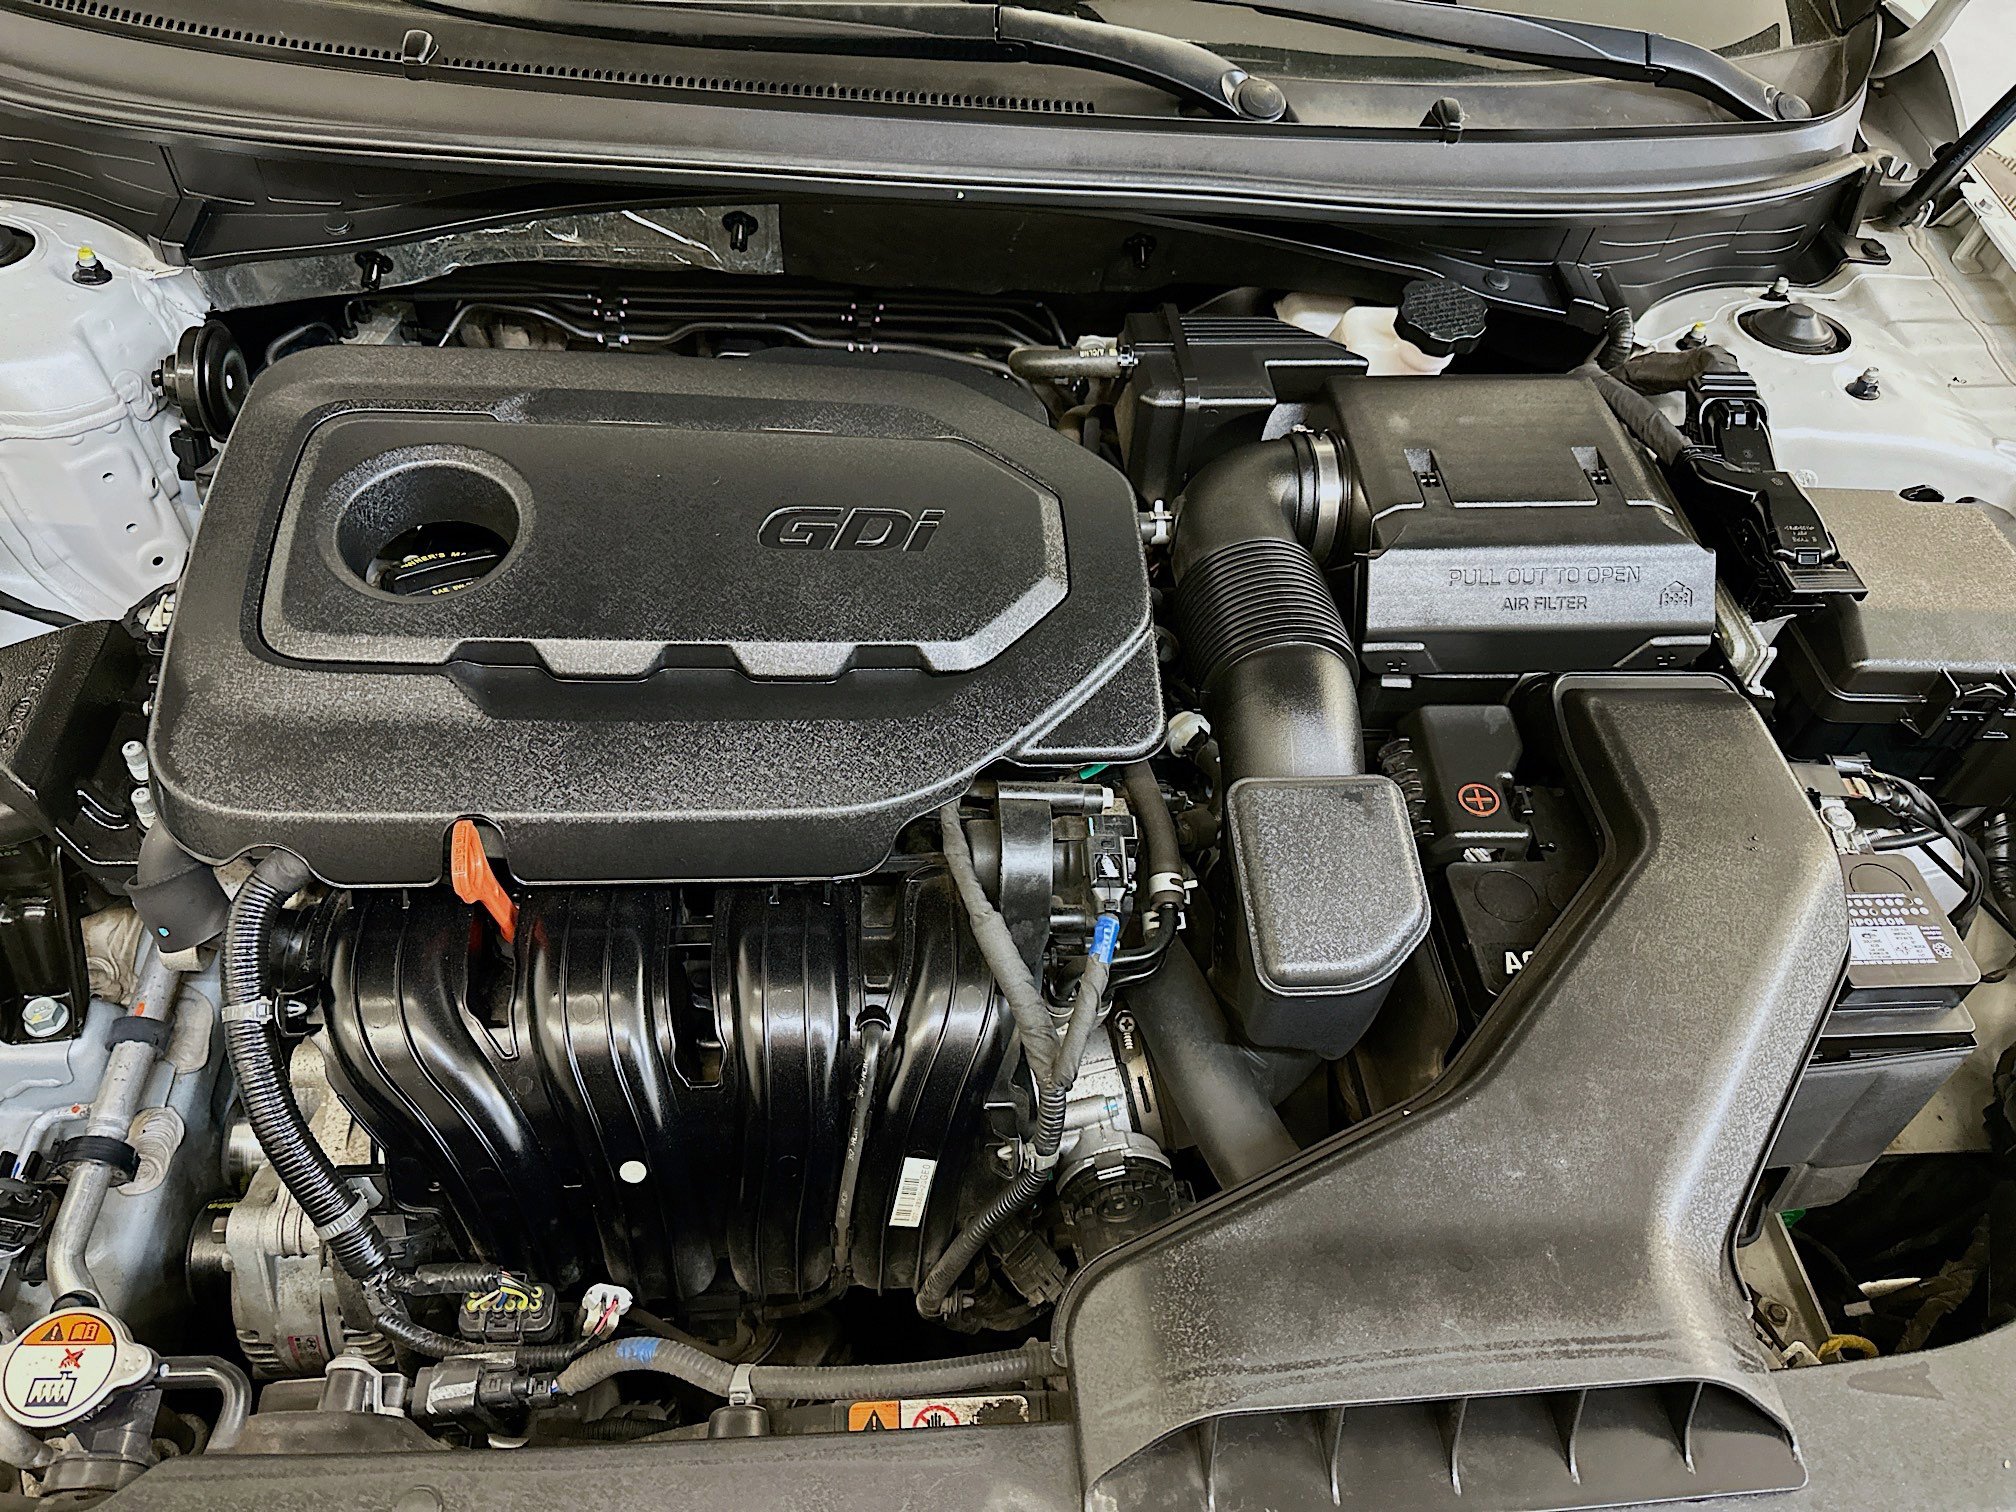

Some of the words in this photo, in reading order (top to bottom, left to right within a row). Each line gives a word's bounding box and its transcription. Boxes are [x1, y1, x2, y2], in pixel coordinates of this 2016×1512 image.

[757, 506, 945, 551] GDi
[1449, 568, 1500, 587] PULL
[1507, 567, 1547, 585] OUT
[1553, 567, 1579, 584] TO
[1587, 565, 1640, 583] OPEN
[431, 586, 451, 595] SAE
[1502, 597, 1529, 611] AIR
[1534, 596, 1588, 610] FILTER
